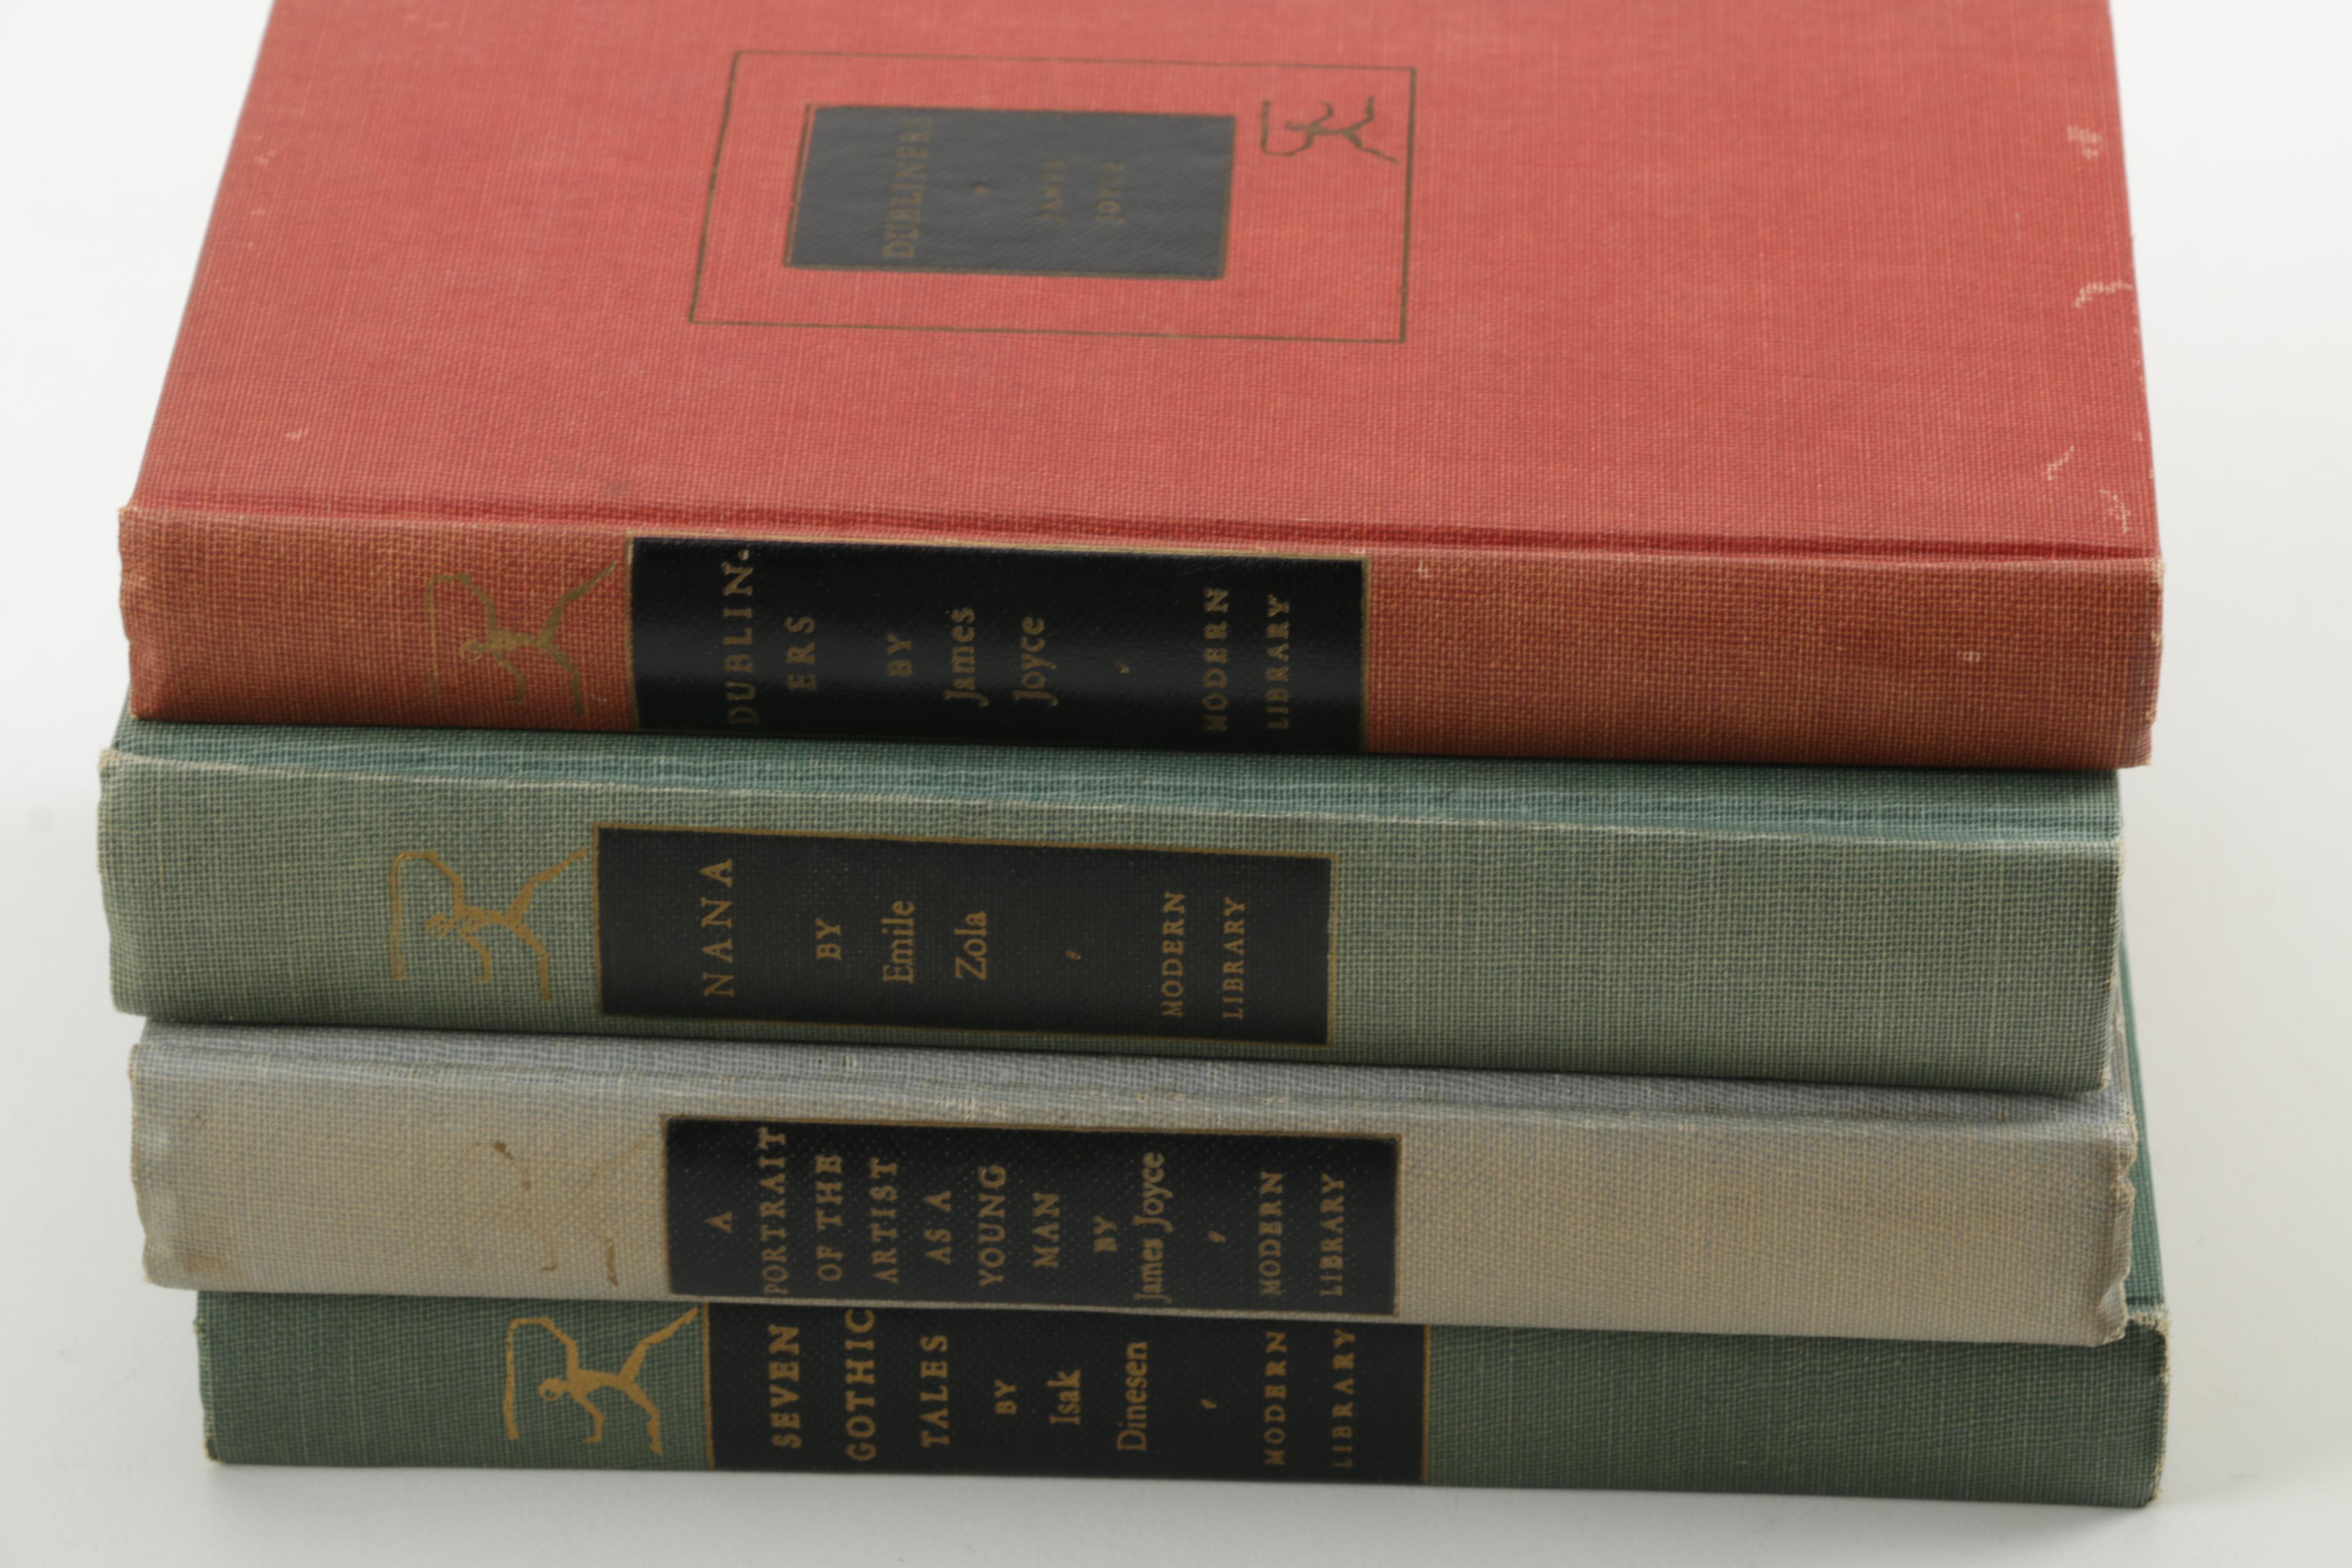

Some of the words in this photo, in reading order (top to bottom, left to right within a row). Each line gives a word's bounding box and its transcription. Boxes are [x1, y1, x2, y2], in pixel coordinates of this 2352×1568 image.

[785, 615, 818, 690] ERS
[886, 632, 913, 678] BY
[943, 606, 990, 707] James
[1010, 616, 1059, 707] Joyce
[1202, 587, 1230, 732] MODERN
[1264, 593, 1290, 730] LIBRARY
[699, 858, 736, 998] NANA
[815, 917, 842, 961] BY
[881, 900, 916, 985] Emile
[954, 910, 988, 980] Zola
[1161, 890, 1186, 1018] MODERN
[1221, 896, 1246, 1021] LIBRARY
[706, 1211, 733, 1233] A
[758, 1126, 790, 1295] PORTRAIT
[815, 1153, 843, 1230] THE
[870, 1157, 899, 1284] ARTIST
[922, 1190, 952, 1213] A
[977, 1164, 1007, 1287] YOUNG
[1033, 1191, 1061, 1269] MAN
[1093, 1215, 1118, 1253] BY
[1132, 1151, 1173, 1233] Joyce
[1258, 1170, 1284, 1297] MODERN
[1319, 1173, 1346, 1297] LIBRARY
[816, 1244, 843, 1282] OF
[923, 1228, 952, 1265] AS
[1132, 1238, 1173, 1304] James
[768, 1323, 802, 1449] SEVEN
[844, 1308, 877, 1462] GOTHIC
[919, 1334, 950, 1449] TALES
[994, 1378, 1017, 1415] BY
[1046, 1368, 1081, 1426] Isak
[1116, 1341, 1148, 1452] Dinesen
[1264, 1330, 1288, 1465] MODERN
[1331, 1328, 1355, 1469] LIBRARY
